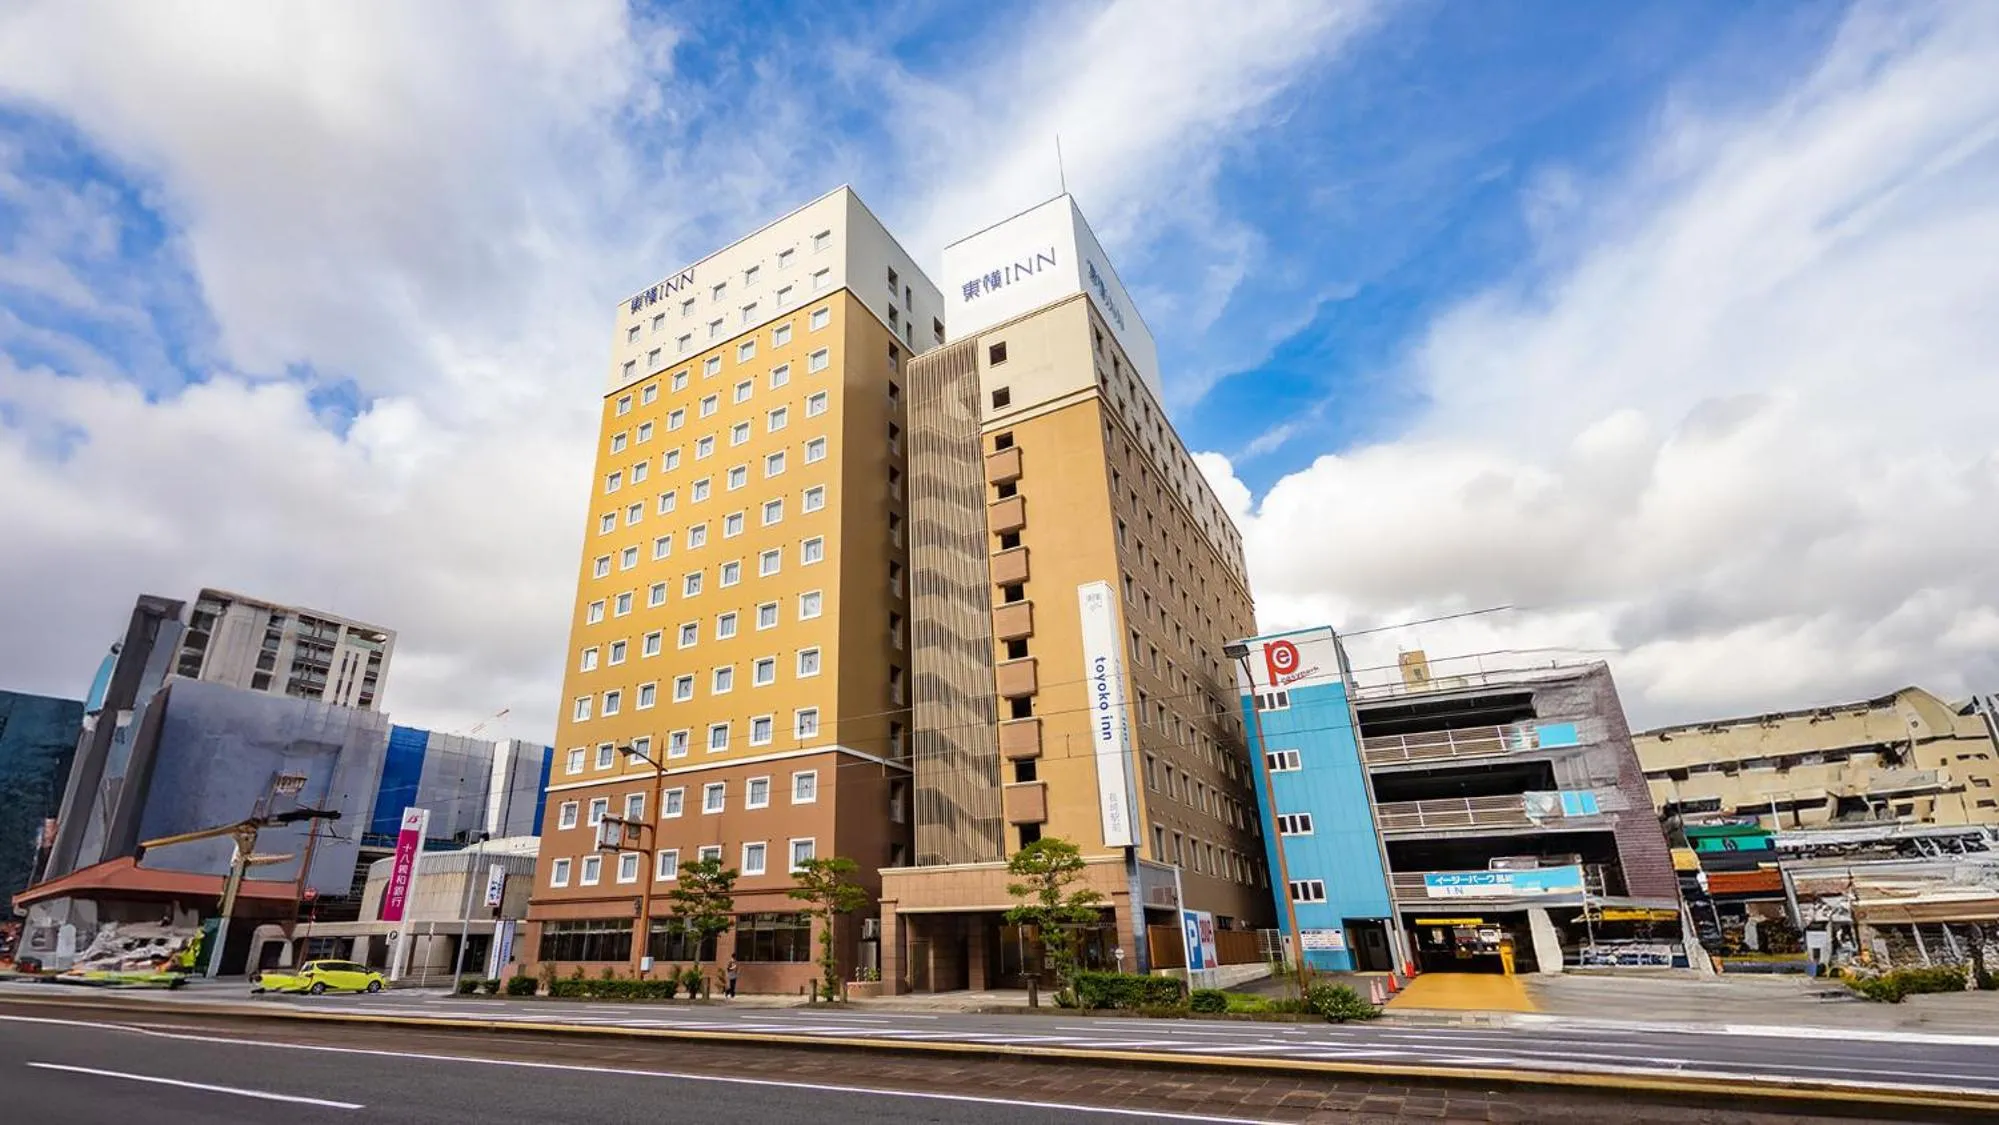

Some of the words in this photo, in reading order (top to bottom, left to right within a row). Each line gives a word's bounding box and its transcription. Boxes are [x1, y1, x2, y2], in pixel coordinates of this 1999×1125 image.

[1094, 656, 1111, 711] toyoko
[1101, 715, 1113, 741] inn
[1186, 920, 1198, 962] P
